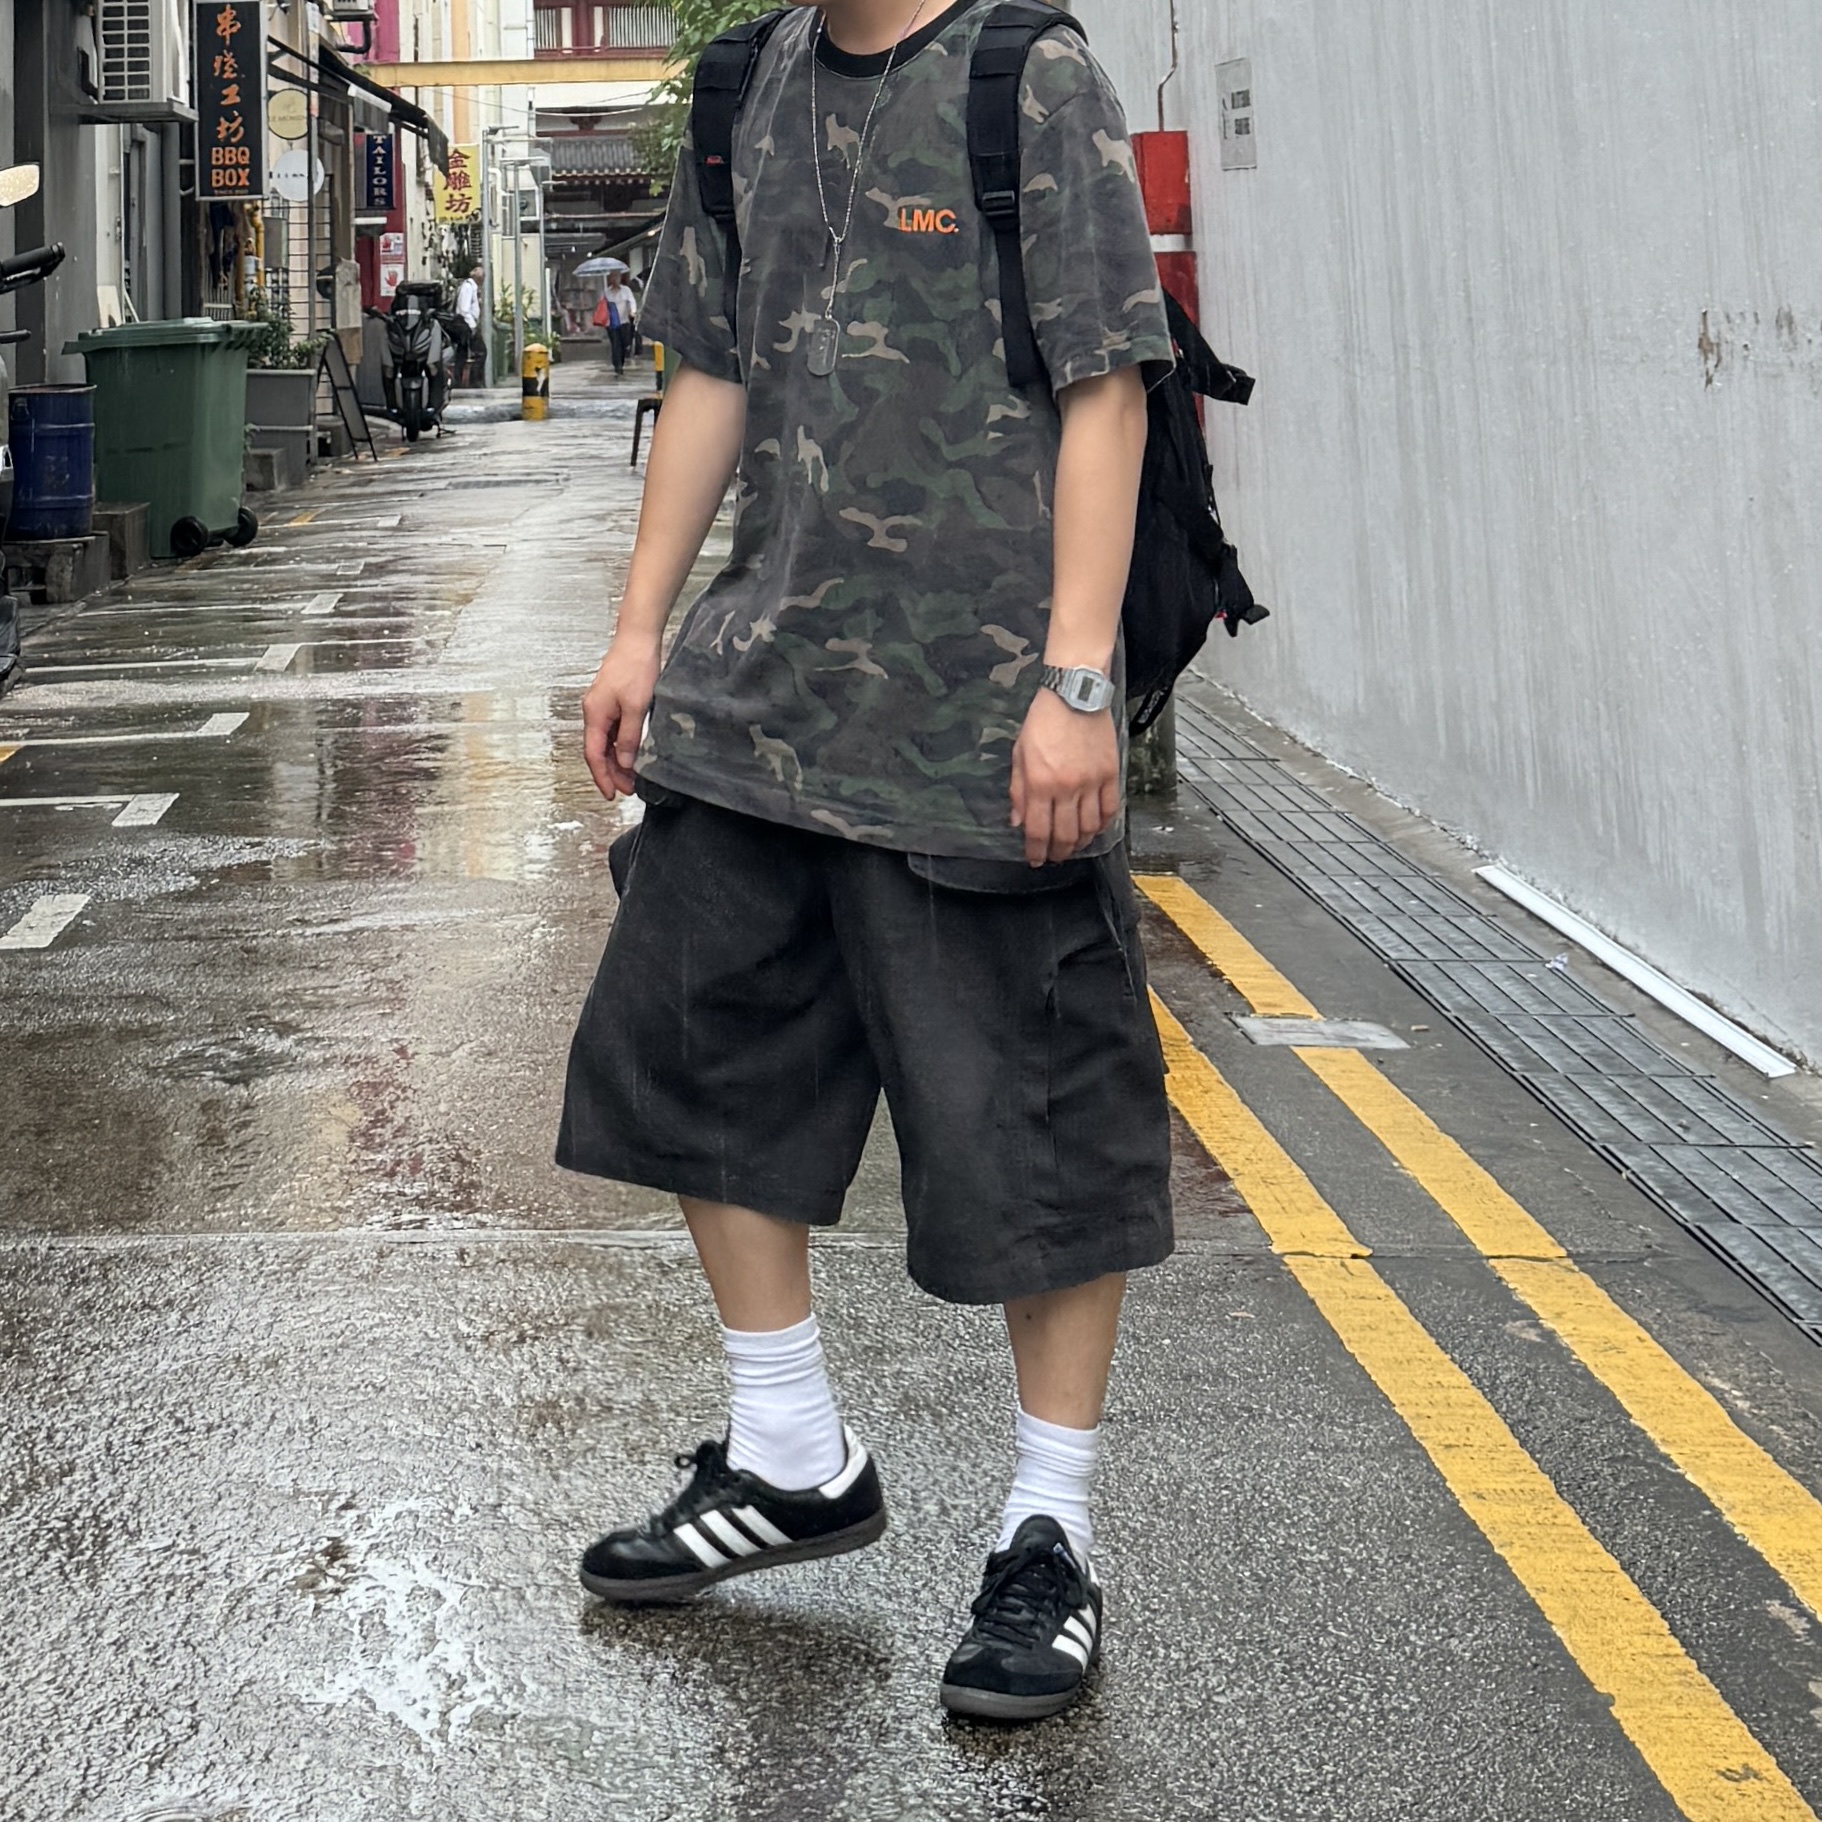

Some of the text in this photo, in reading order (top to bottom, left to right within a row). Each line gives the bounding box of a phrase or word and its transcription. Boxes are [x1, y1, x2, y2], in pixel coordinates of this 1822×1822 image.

[211, 146, 250, 165] BBQ
[211, 168, 250, 187] BOX
[372, 134, 388, 206] TAILORS
[900, 208, 960, 233] LMC.
